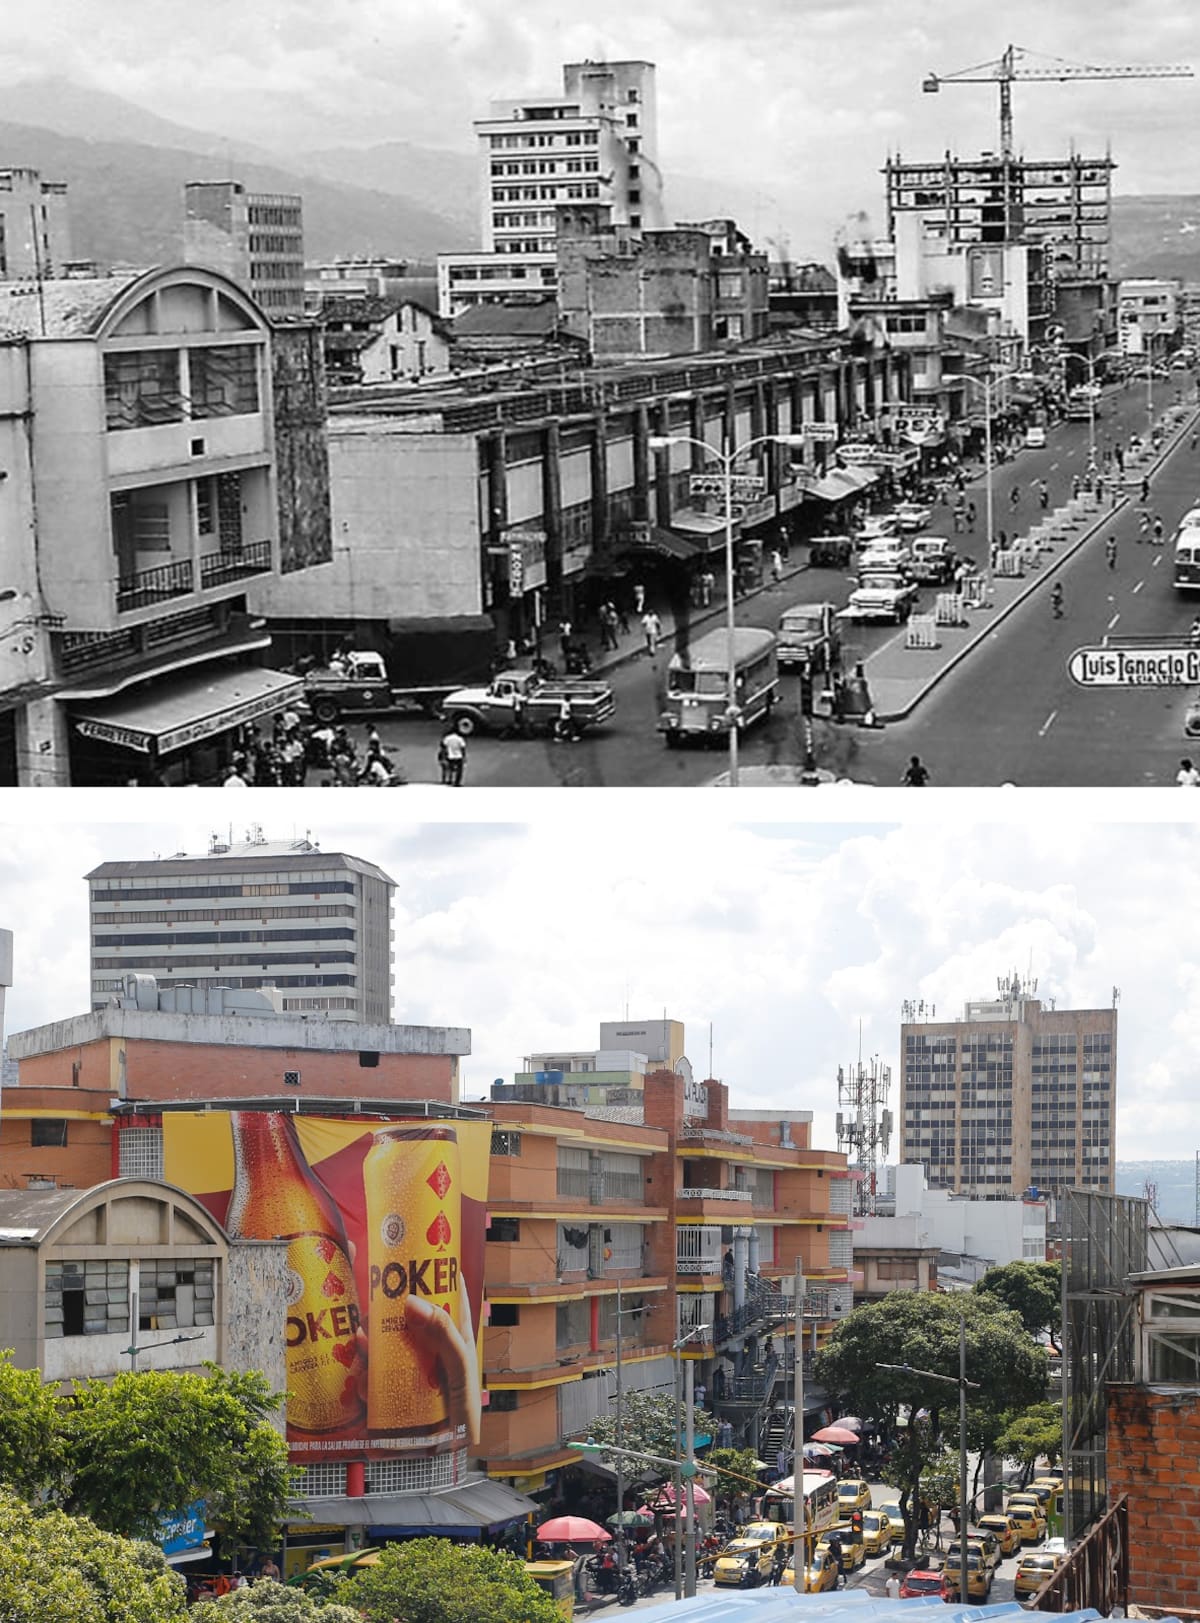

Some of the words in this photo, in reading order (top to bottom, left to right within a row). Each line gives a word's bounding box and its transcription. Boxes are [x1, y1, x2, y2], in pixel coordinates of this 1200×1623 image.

[895, 419, 939, 432] REX
[1187, 651, 1200, 681] G
[370, 1256, 458, 1301] POKER
[286, 1303, 361, 1347] OKER
